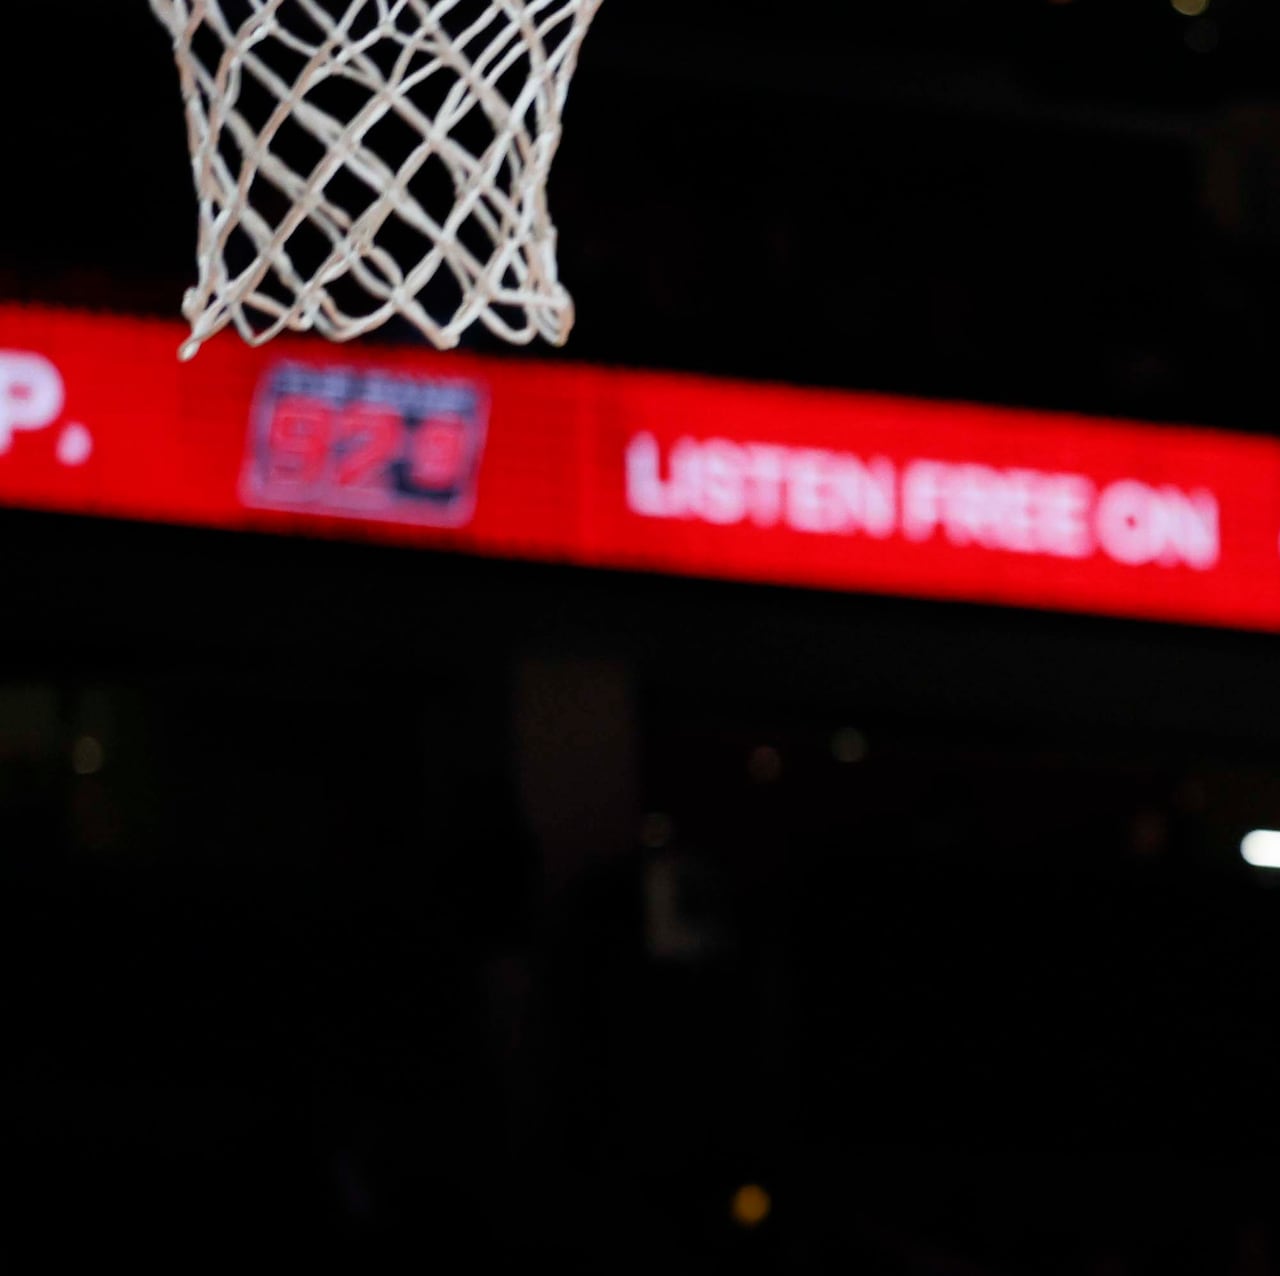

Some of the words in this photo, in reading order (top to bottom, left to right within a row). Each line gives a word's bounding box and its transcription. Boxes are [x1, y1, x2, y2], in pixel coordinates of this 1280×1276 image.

[625, 431, 896, 539] LISTEN
[901, 458, 1097, 560] FREE
[1096, 478, 1219, 570] ON
